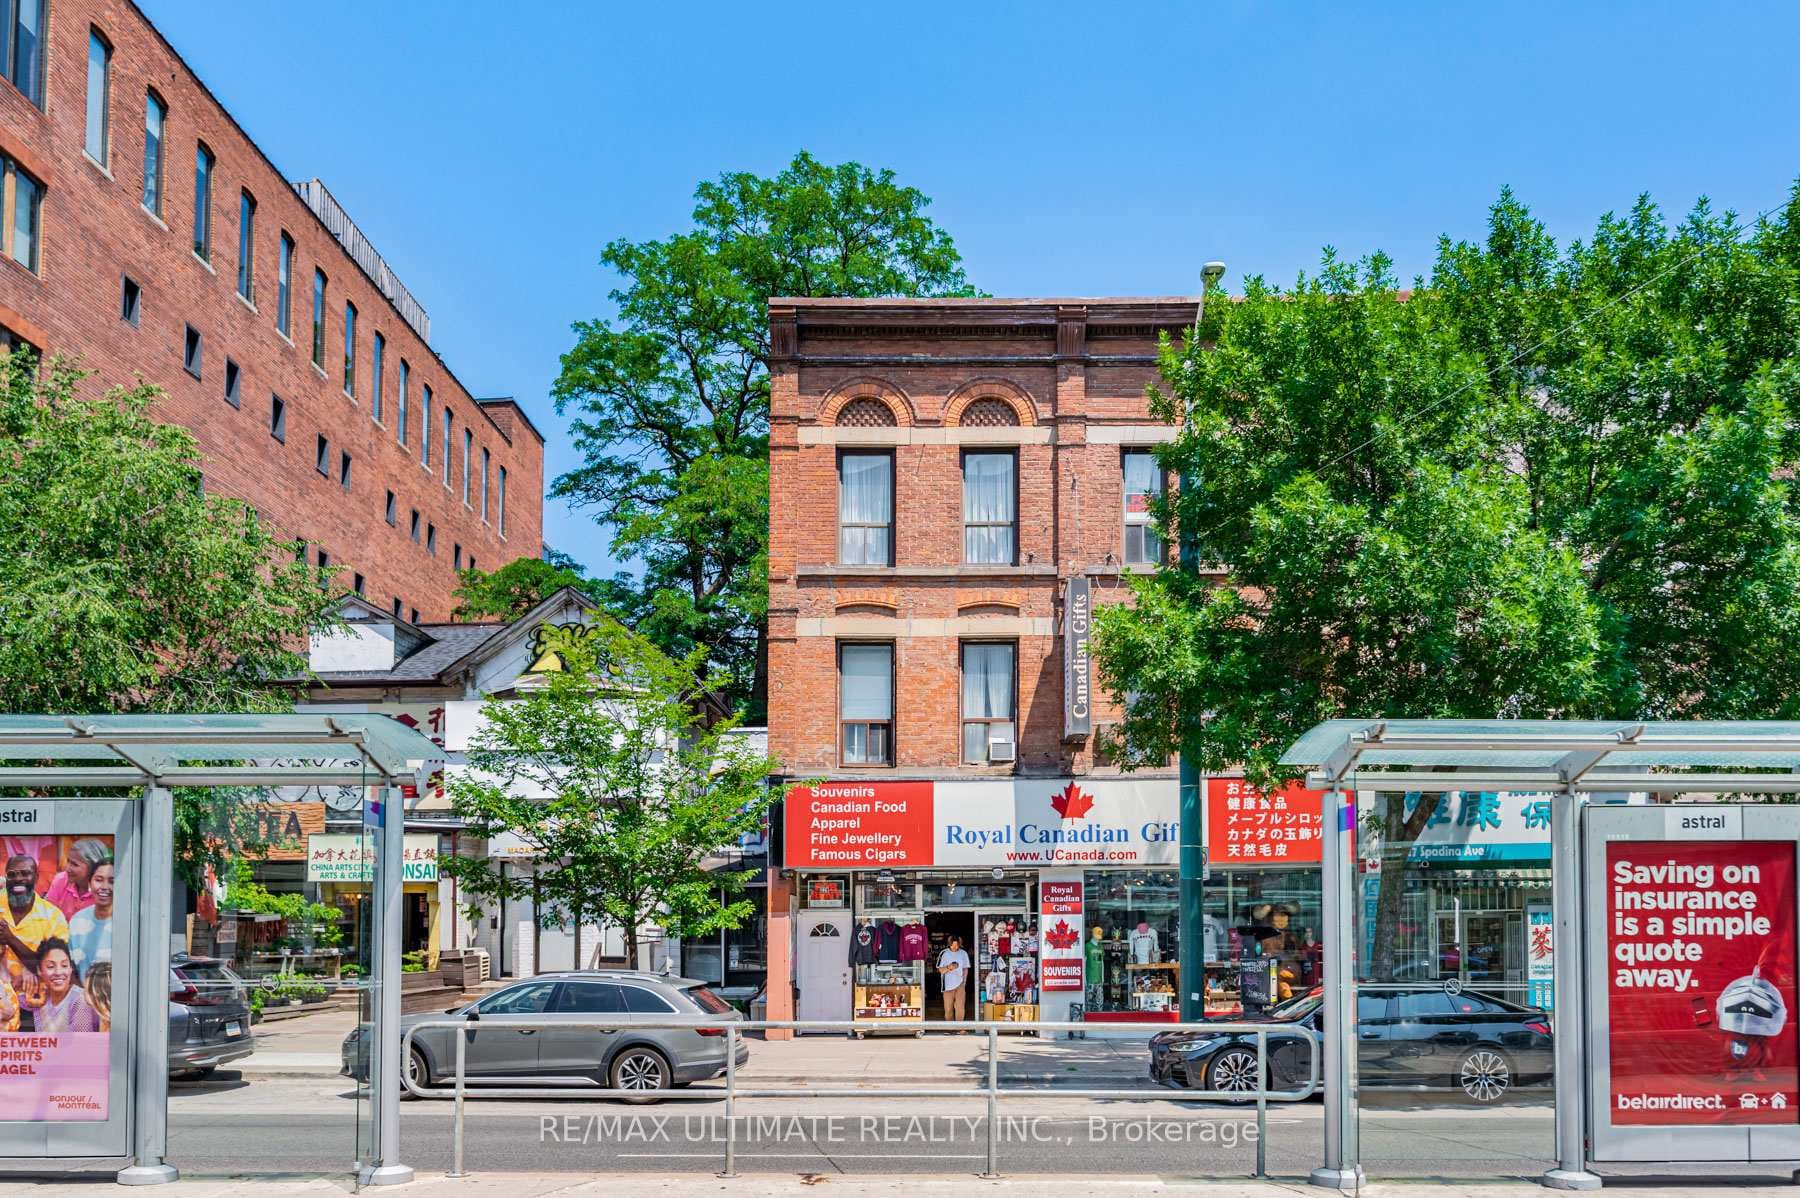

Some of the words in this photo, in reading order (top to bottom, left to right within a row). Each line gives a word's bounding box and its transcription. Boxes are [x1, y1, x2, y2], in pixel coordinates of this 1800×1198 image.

[1072, 594, 1087, 634] Gifts
[1073, 638, 1088, 719] Canadian
[810, 786, 875, 797] Souvenirs
[1227, 782, 1268, 795] お土
[811, 801, 870, 813] Canadian
[874, 801, 907, 813] Food
[1227, 797, 1287, 810] 健康食品
[0, 809, 37, 822] stral
[1227, 812, 1322, 825] メープルシロッ
[1682, 815, 1725, 829] astral
[811, 817, 861, 831] Apparel
[811, 833, 838, 844] Fine
[841, 833, 902, 846] Jewellery
[947, 824, 1011, 849] Royal
[1019, 824, 1128, 844] Canadian
[1141, 822, 1180, 842] Gif
[811, 848, 861, 860] Famous
[865, 848, 907, 862] Cigars
[1007, 849, 1137, 861] www.UCanada.com
[1227, 843, 1288, 856] 天然毛皮
[1420, 846, 1461, 860] Spadina
[1464, 845, 1485, 856] Ave
[310, 863, 334, 871] CHINA
[335, 863, 352, 871] ARTS
[402, 864, 436, 879] NSAI
[1614, 860, 1714, 888] Saving
[1722, 865, 1760, 883] on
[1615, 886, 1757, 909] insurance
[1615, 912, 1639, 935] is
[1646, 917, 1664, 935] a
[1672, 912, 1771, 940] simple
[1615, 939, 1703, 966] quote
[1043, 966, 1081, 976] SOUVENIRS
[1615, 968, 1699, 992] away.
[0, 1037, 58, 1048] ETWEEN
[0, 1051, 42, 1061] PIRITS
[0, 1064, 36, 1075] AGEL
[1617, 1093, 1726, 1110] belairdirect.
